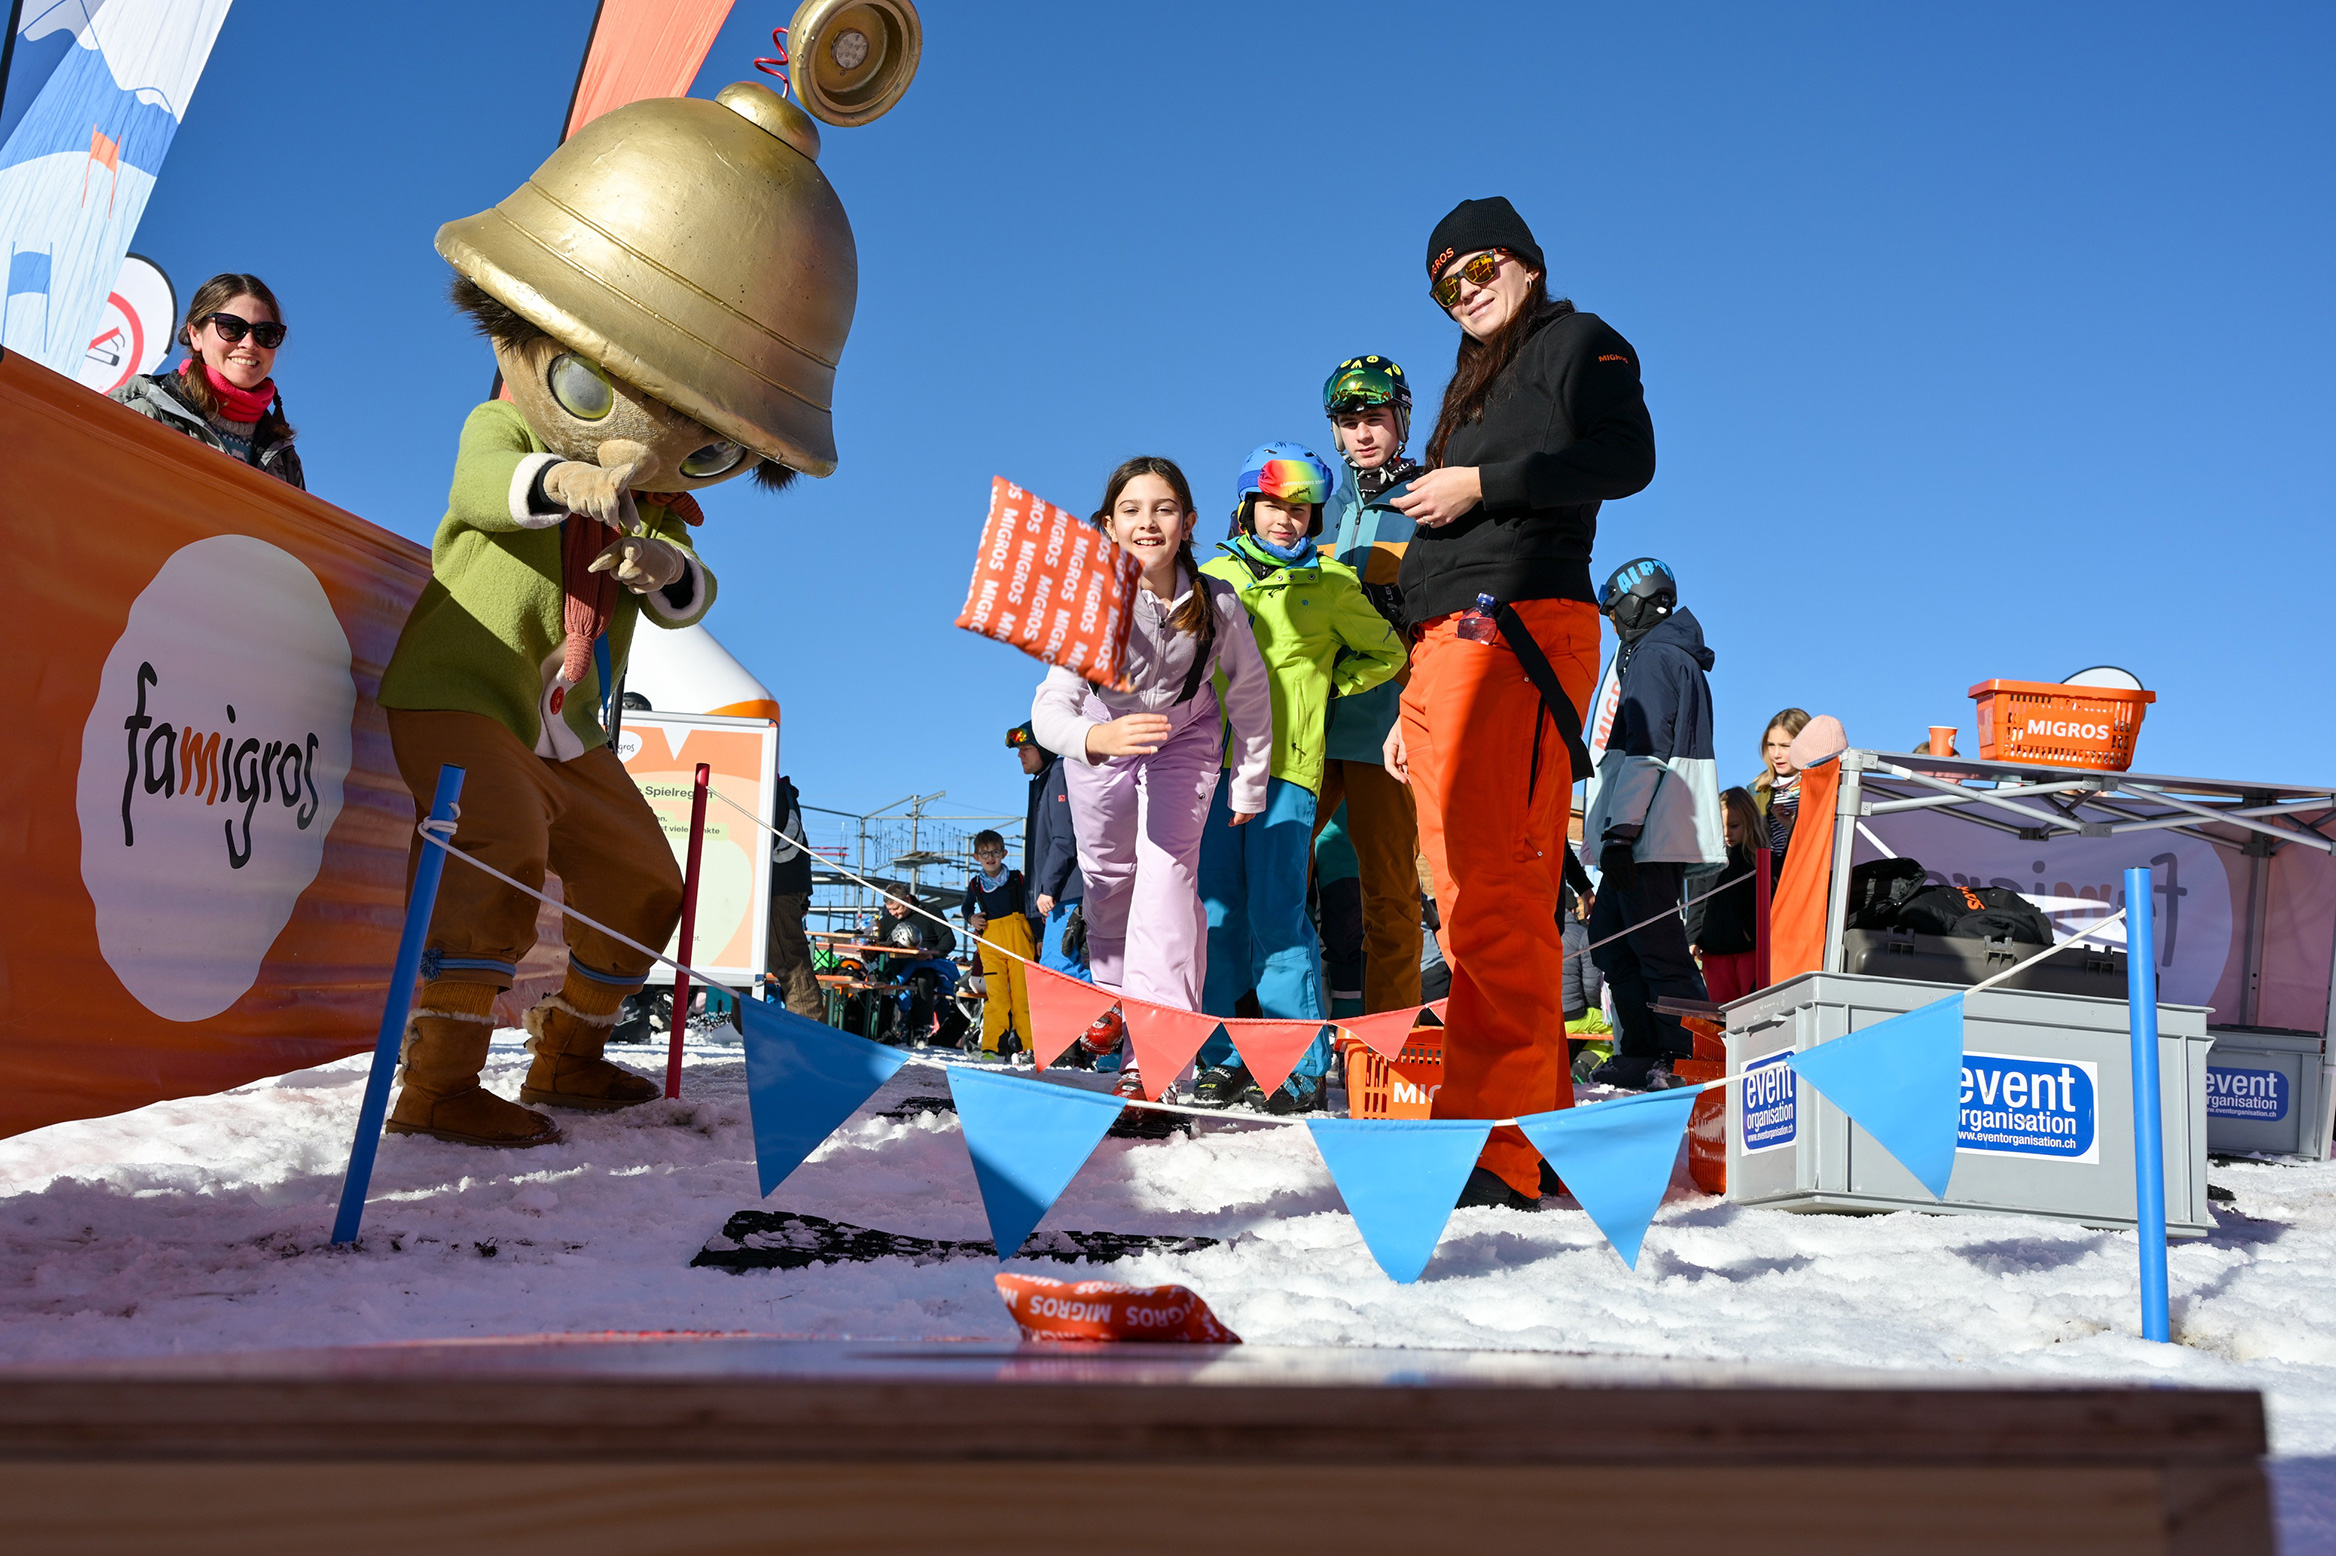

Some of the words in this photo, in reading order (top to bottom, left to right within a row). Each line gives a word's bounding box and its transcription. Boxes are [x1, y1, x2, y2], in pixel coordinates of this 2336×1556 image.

[989, 507, 1018, 571] MIGROS
[1007, 540, 1037, 605] MIGROS
[1061, 536, 1089, 602] MIGROS
[1023, 574, 1053, 641] MIGROS
[1080, 570, 1105, 634] MIGROS
[2027, 719, 2110, 741] MIGROS
[121, 660, 319, 869] famigros
[1747, 1055, 1793, 1109] event
[1960, 1066, 2076, 1112] event
[2206, 1072, 2278, 1098] event
[2207, 1095, 2277, 1110] rganisation
[1747, 1101, 1794, 1132] organisation
[1958, 1130, 2077, 1149] ww.eventorganisation.ch
[1959, 1108, 2077, 1135] rganisation
[1030, 1295, 1112, 1324] MIGROS
